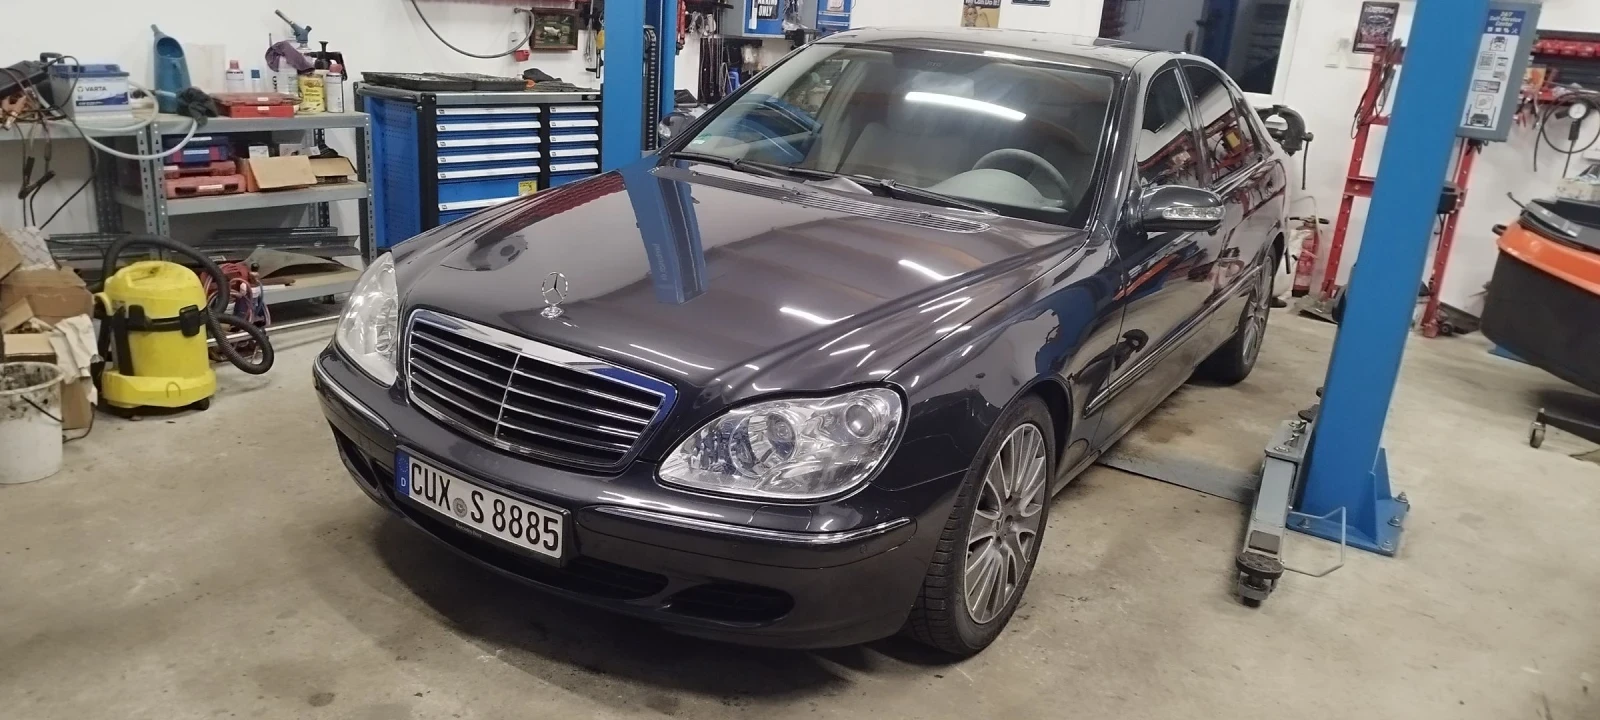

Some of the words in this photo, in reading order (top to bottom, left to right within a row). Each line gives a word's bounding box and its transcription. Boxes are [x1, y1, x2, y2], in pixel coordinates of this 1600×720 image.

[758, 5, 774, 17] ONLY
[400, 477, 407, 487] D
[411, 462, 451, 511] CUX
[470, 490, 484, 524] S
[492, 498, 559, 552] 8885
